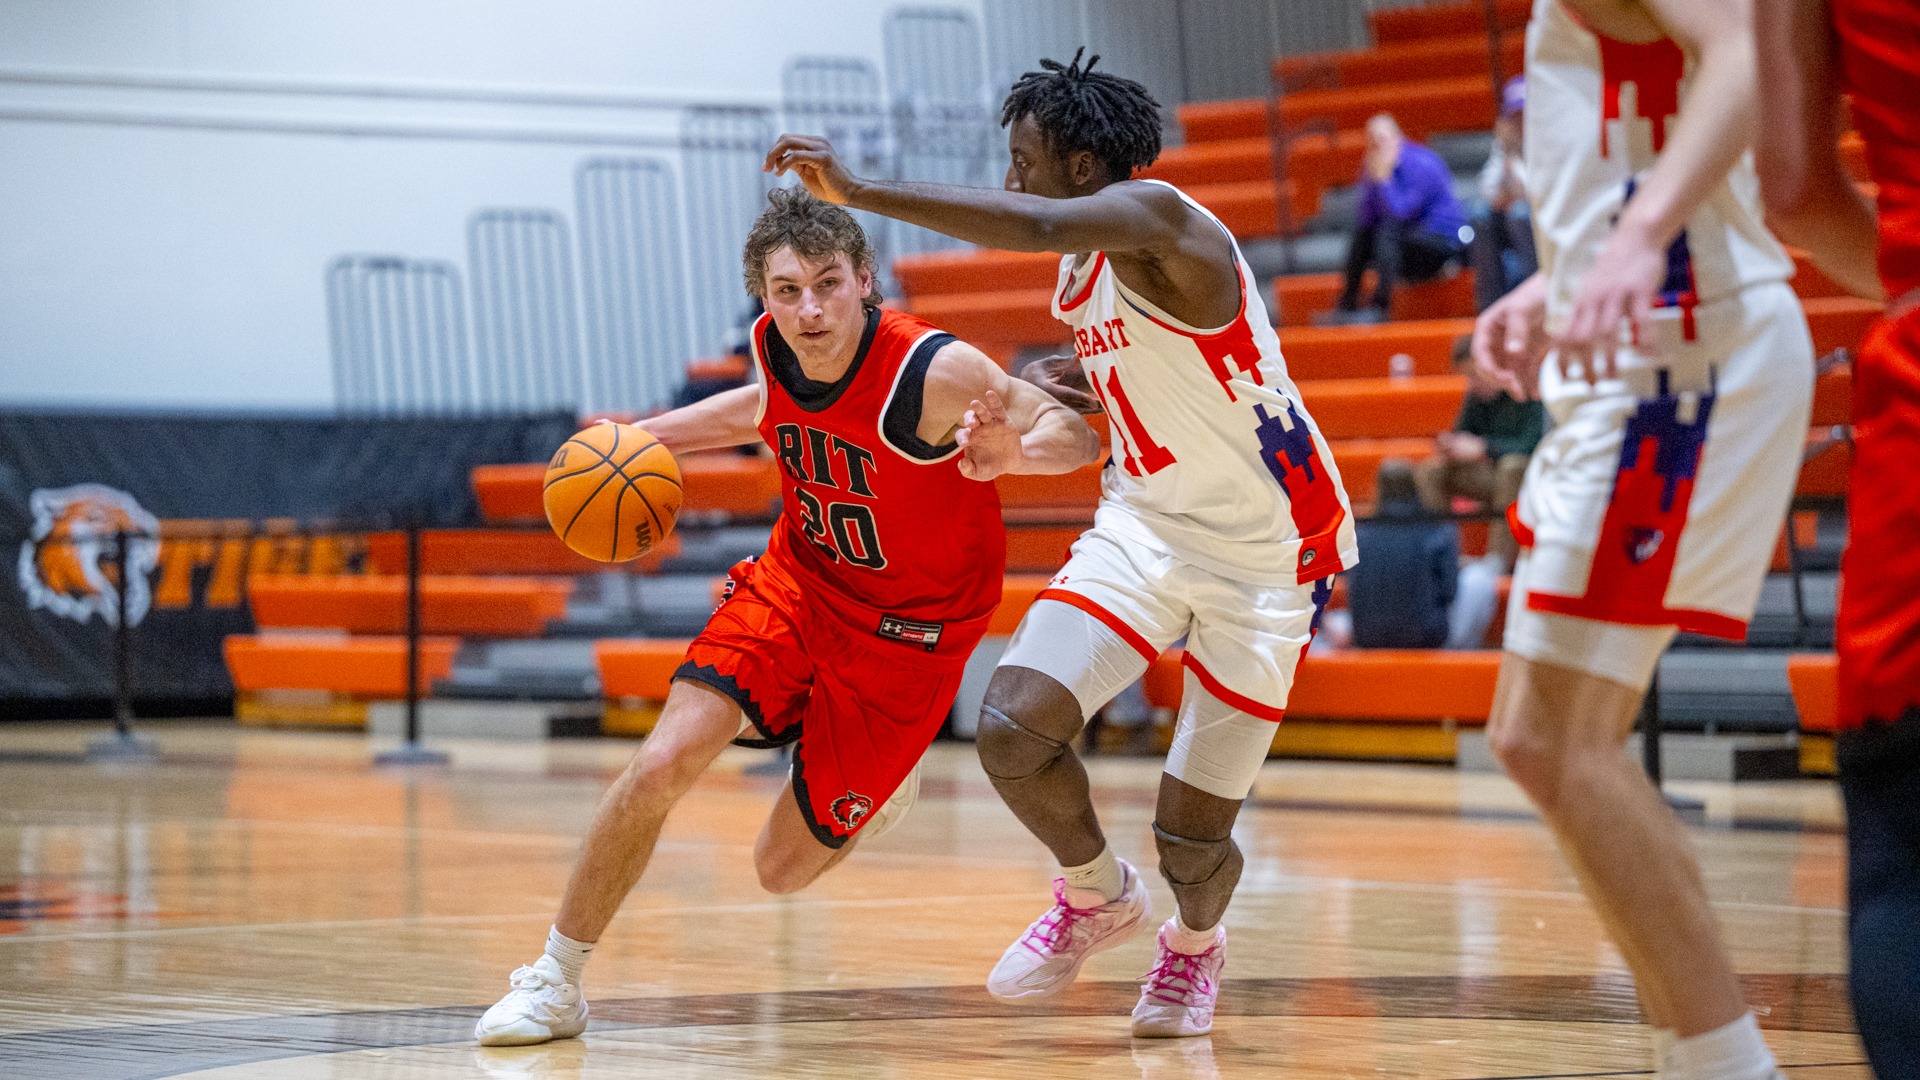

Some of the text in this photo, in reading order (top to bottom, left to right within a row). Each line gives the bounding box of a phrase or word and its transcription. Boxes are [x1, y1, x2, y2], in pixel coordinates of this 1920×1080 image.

[774, 423, 879, 499] RIT
[1090, 365, 1178, 478] 11
[793, 486, 888, 571] 20
